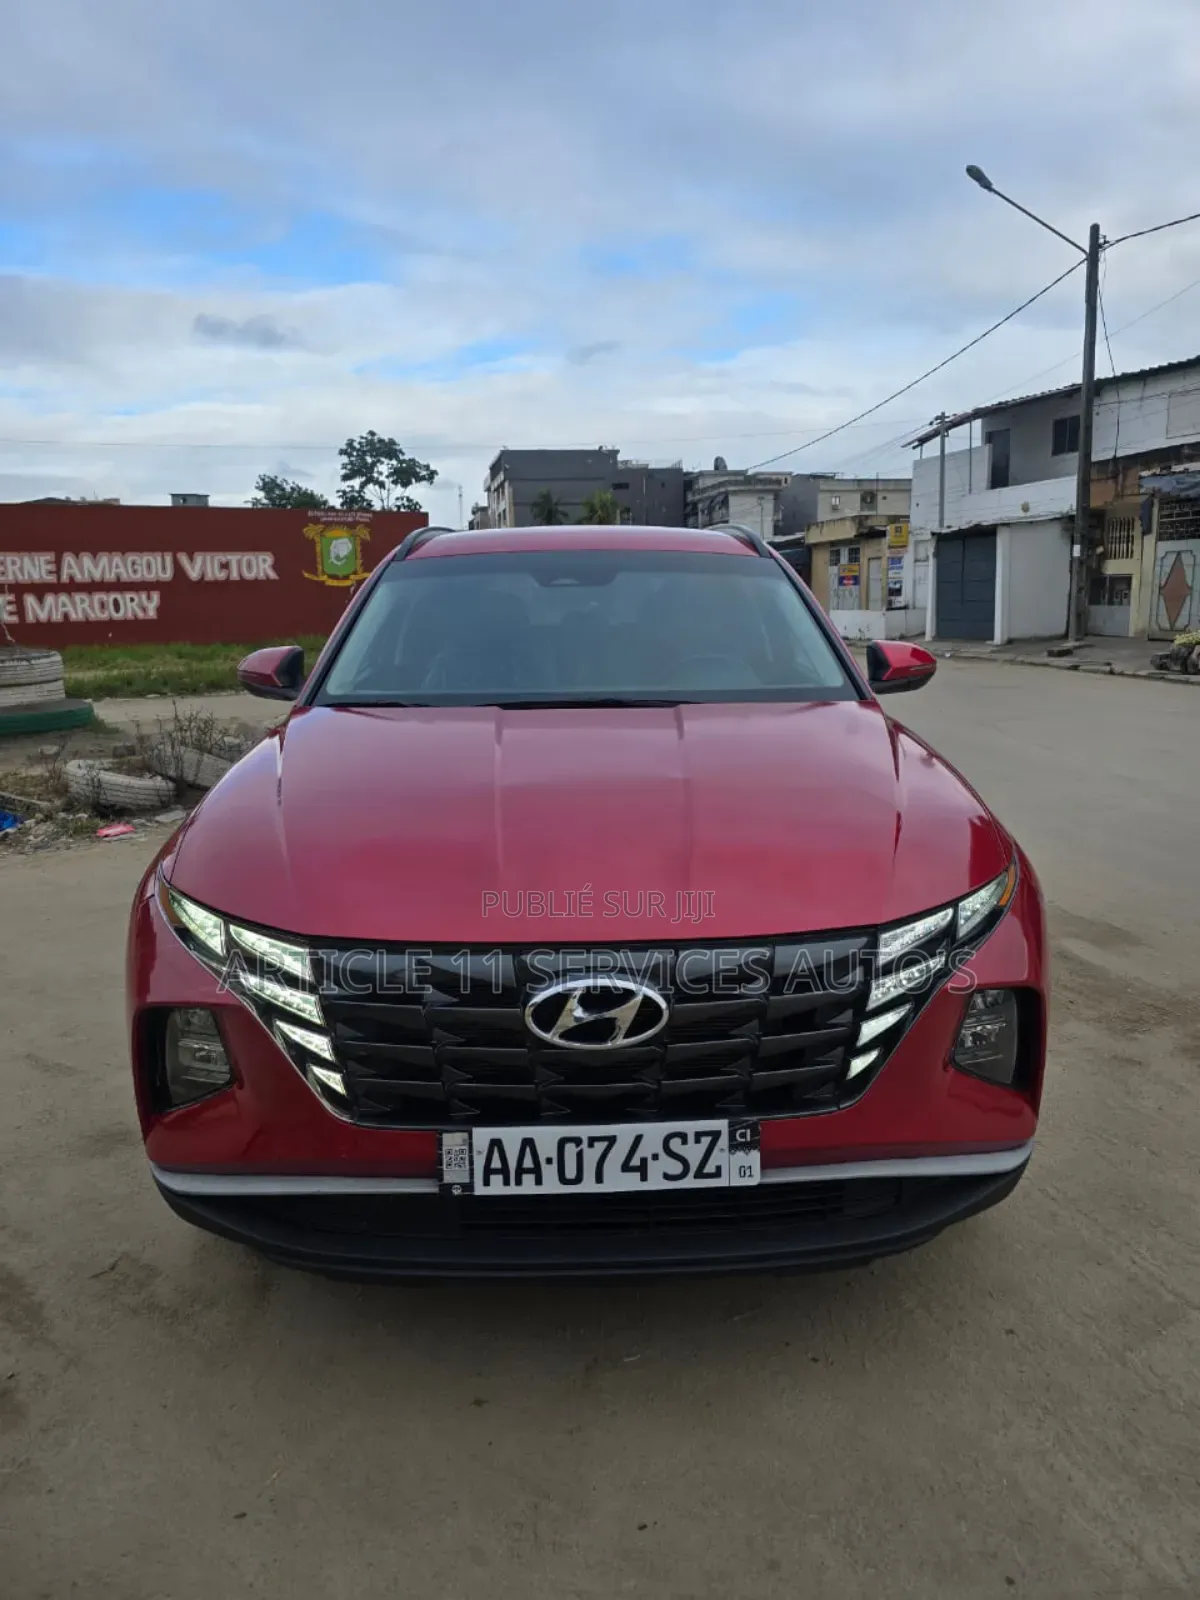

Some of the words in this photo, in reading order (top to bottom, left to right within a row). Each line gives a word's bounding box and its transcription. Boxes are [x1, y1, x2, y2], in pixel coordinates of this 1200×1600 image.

[61, 551, 175, 583] AMAGOU
[176, 551, 279, 582] VICTOR
[23, 591, 161, 623] MARCORY
[735, 1129, 751, 1142] CI
[739, 1165, 754, 1178] 01
